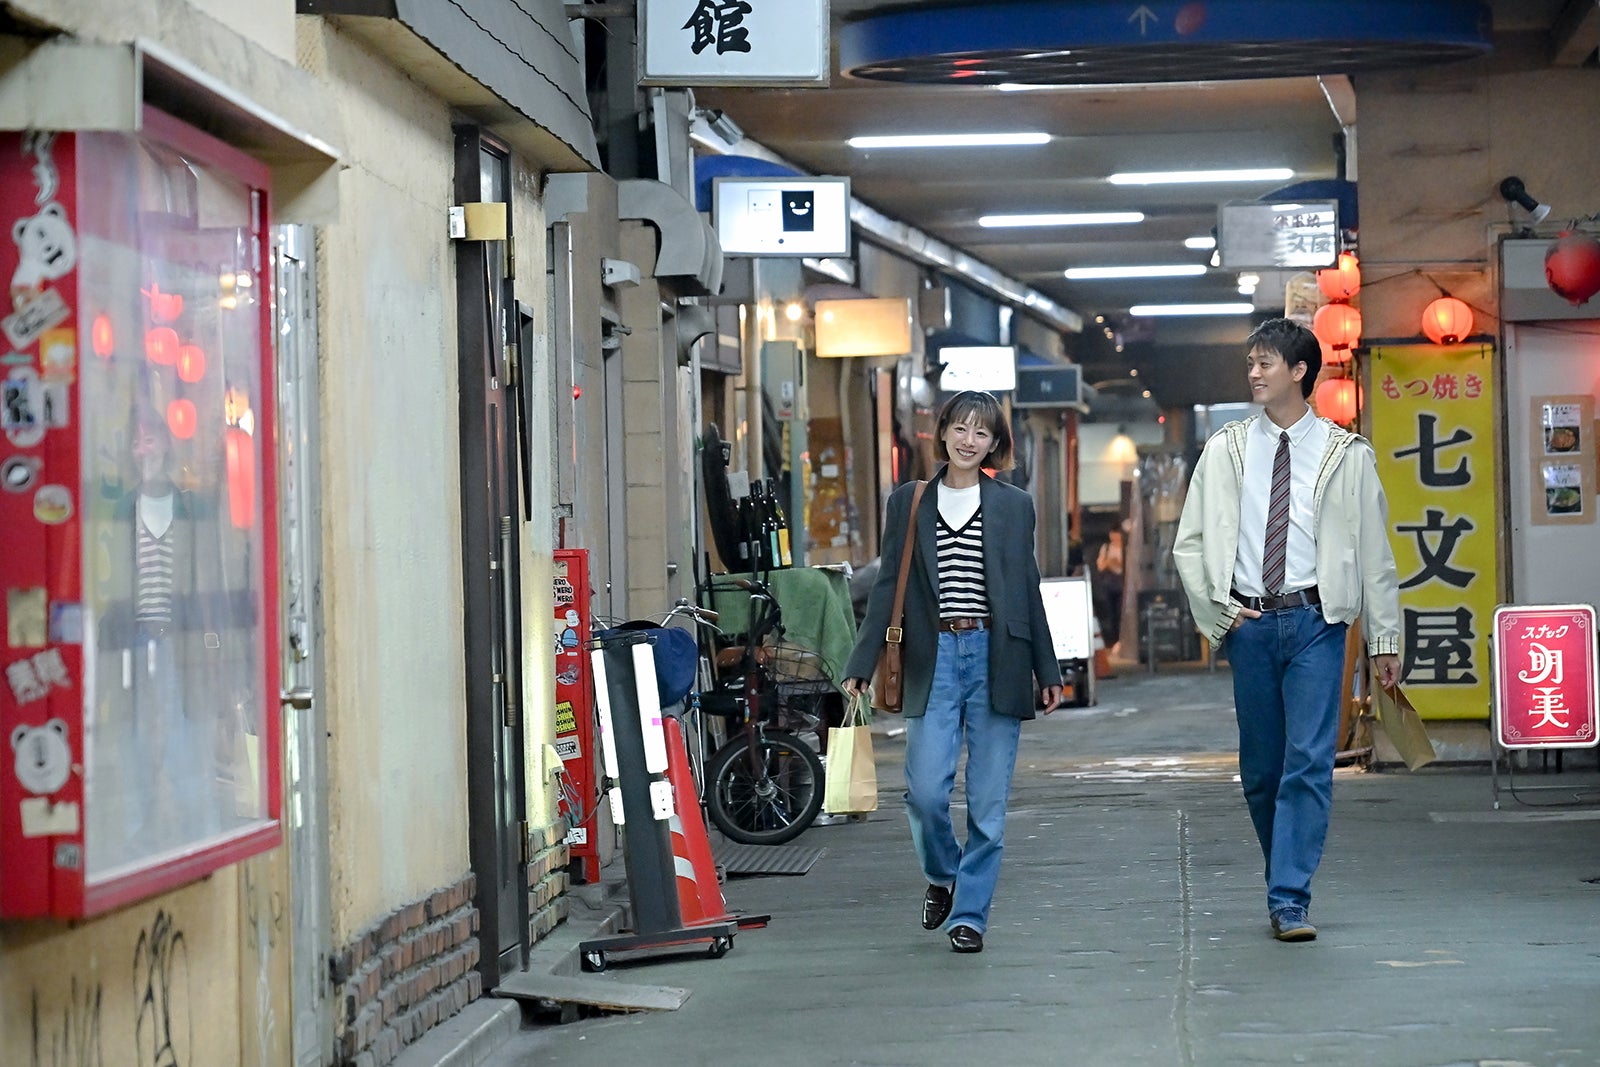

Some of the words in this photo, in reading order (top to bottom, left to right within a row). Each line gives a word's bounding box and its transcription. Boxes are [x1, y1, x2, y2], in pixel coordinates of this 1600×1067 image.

[681, 0, 752, 55] 館
[1381, 373, 1483, 400] もつ焼き
[1394, 413, 1478, 686] 七文屋
[1521, 624, 1569, 639] スナック
[1518, 642, 1570, 729] 明美
